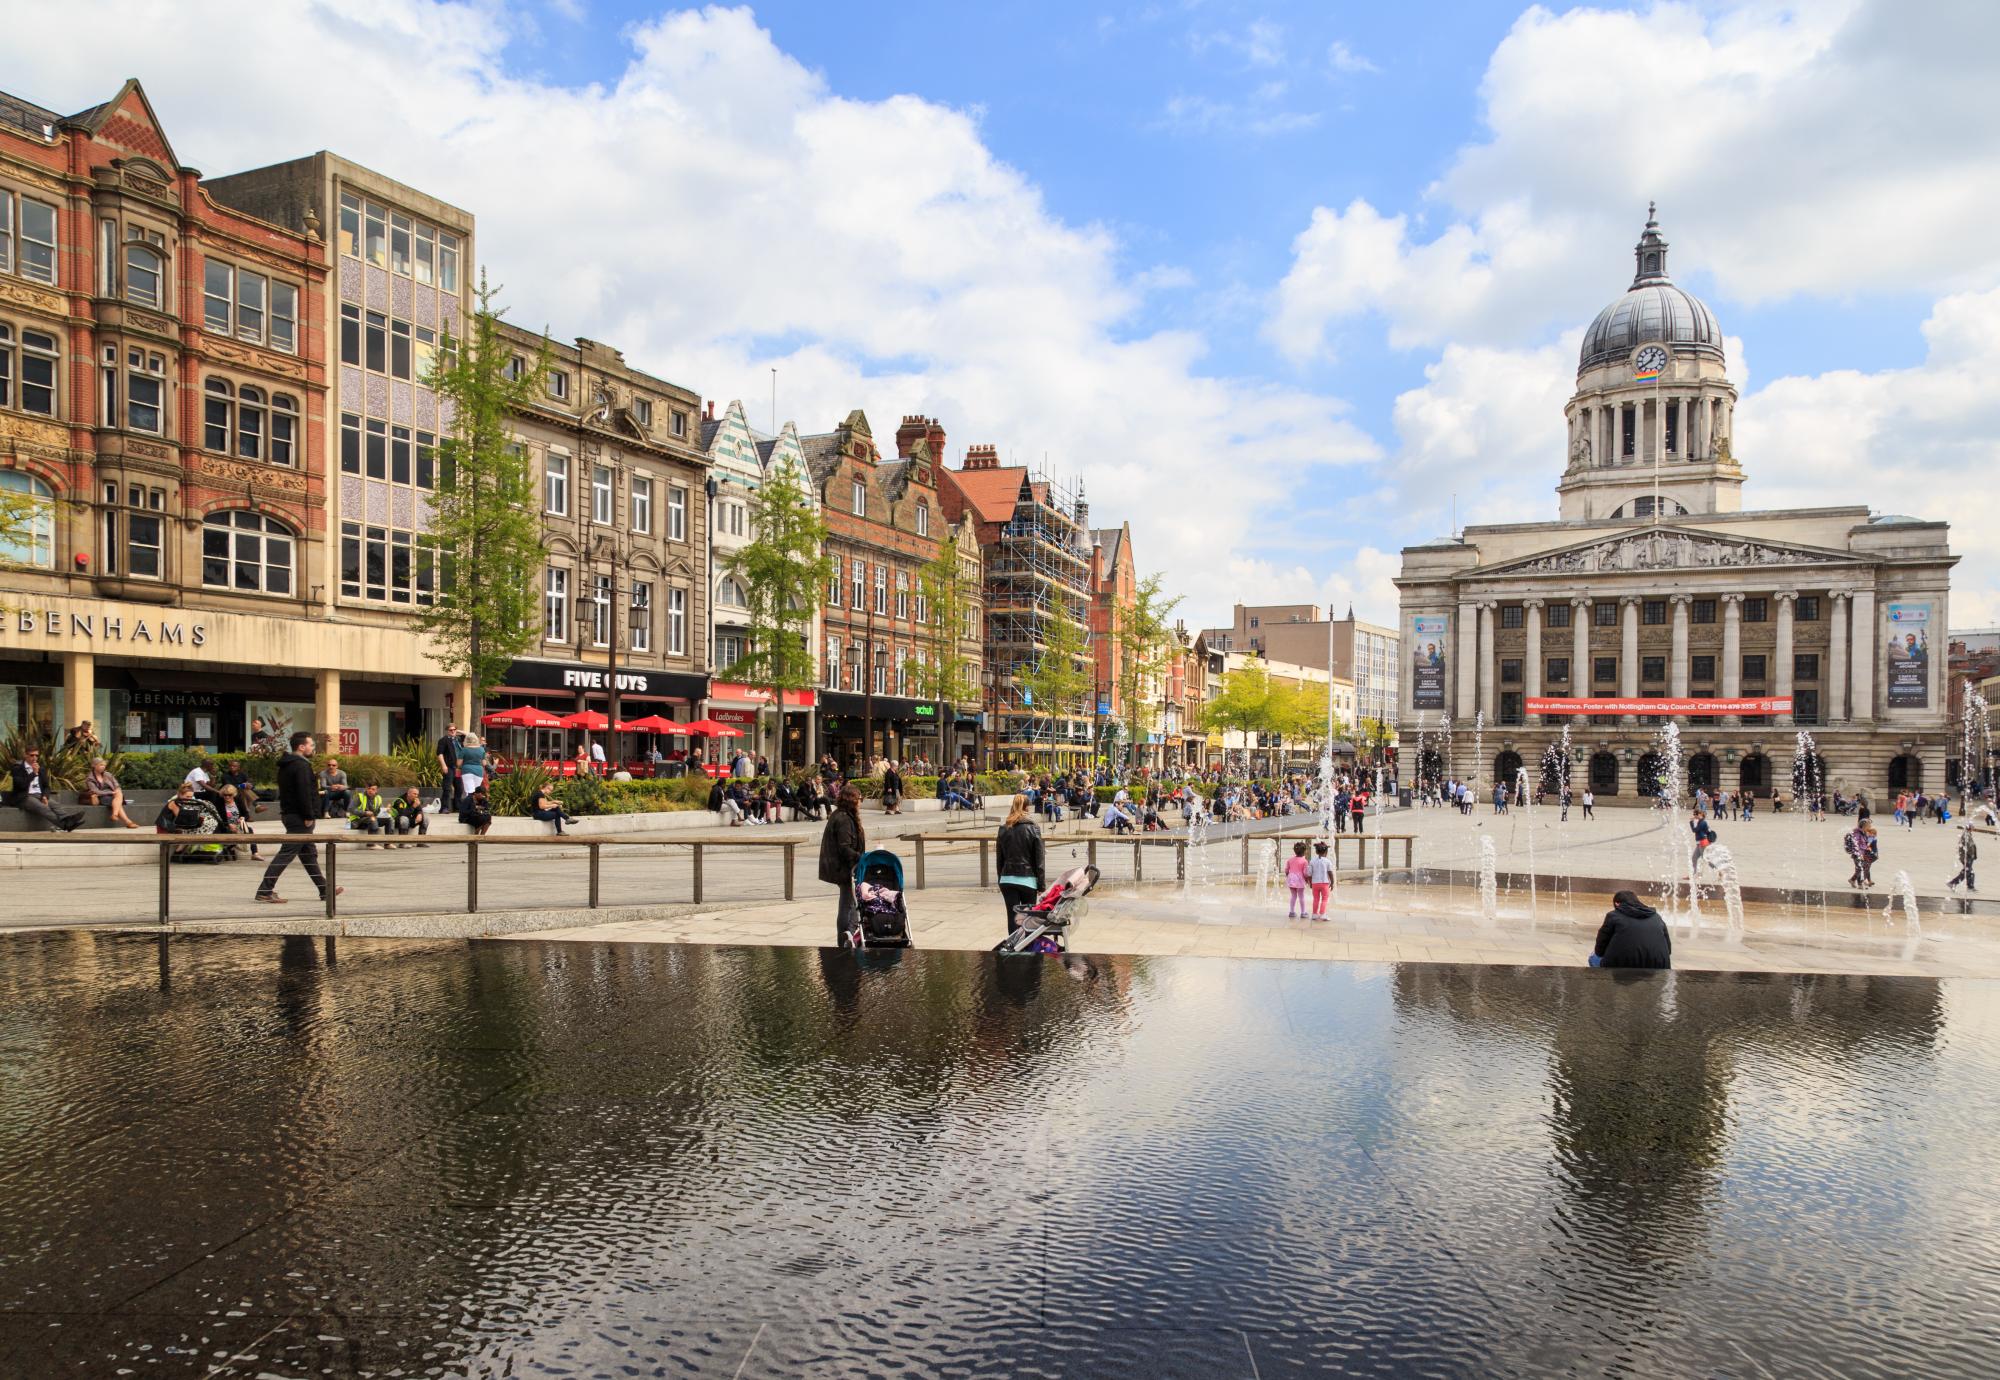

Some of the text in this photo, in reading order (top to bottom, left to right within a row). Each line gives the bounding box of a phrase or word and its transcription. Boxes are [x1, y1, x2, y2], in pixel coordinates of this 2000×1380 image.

[563, 670, 602, 688] FIVE
[122, 693, 220, 706] DEBENHAMS
[915, 704, 934, 716] schuh
[1618, 703, 1656, 711] Nottingham
[1656, 703, 1669, 711] City
[715, 711, 744, 722] Ladbrokes
[338, 745, 353, 753] OFF
